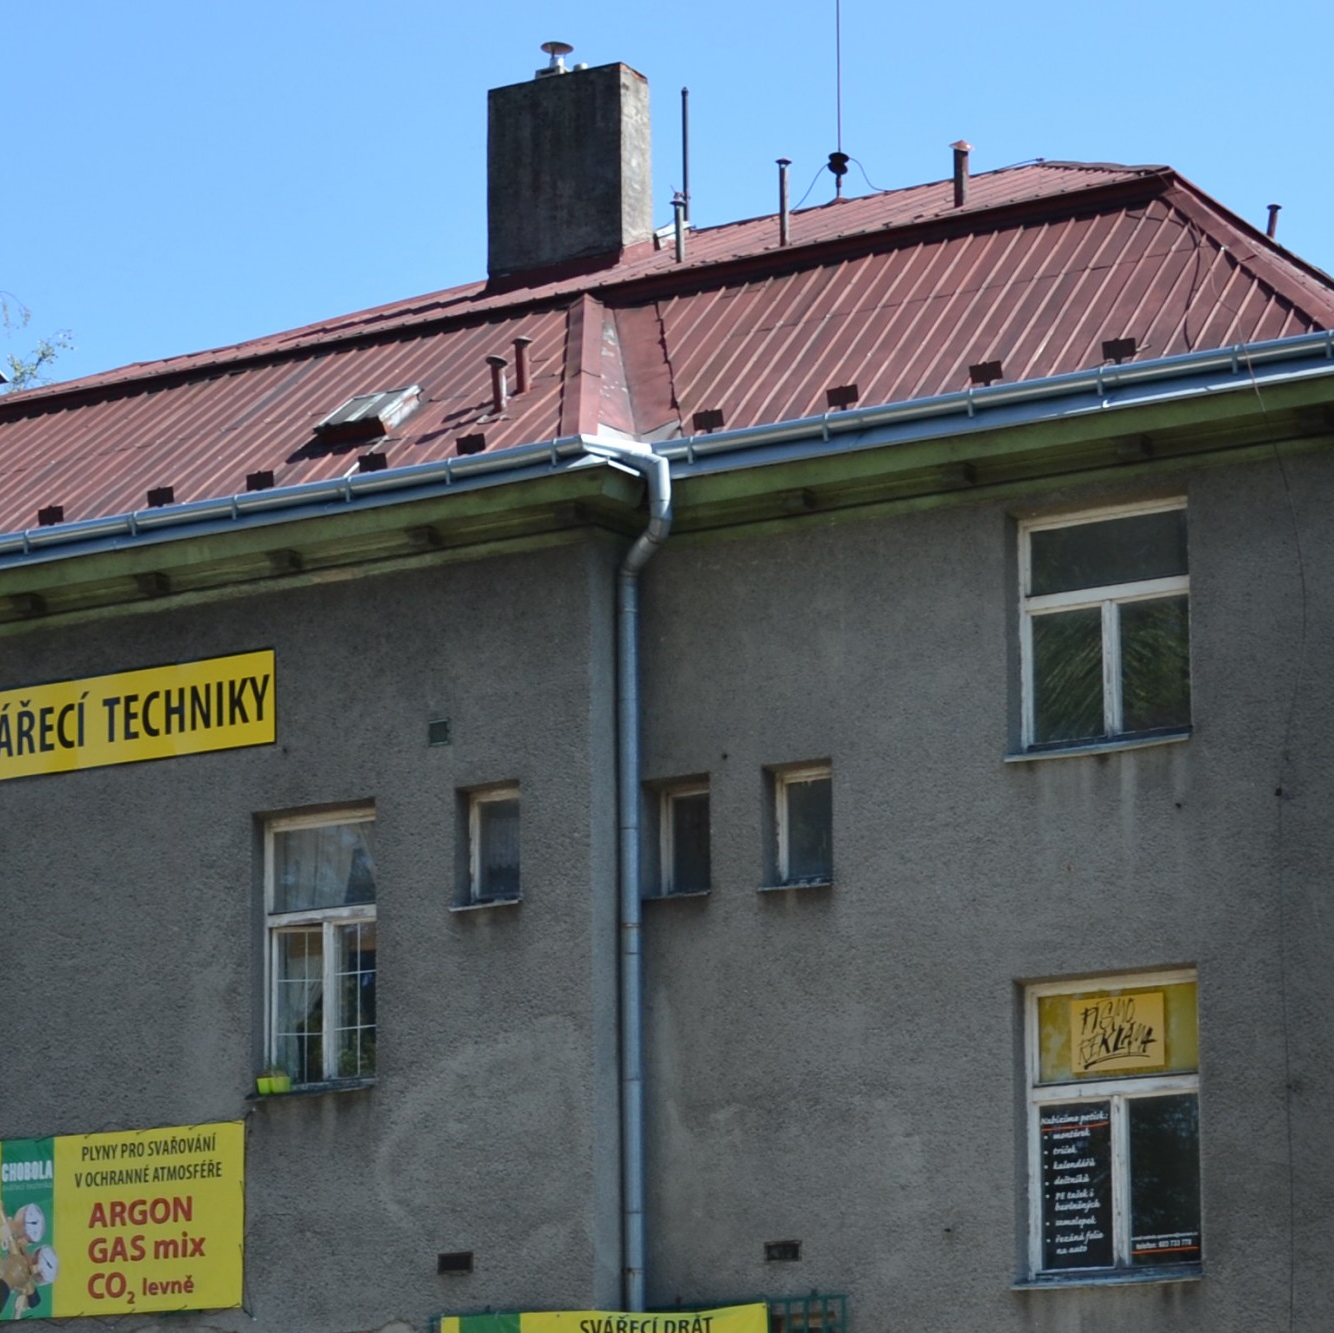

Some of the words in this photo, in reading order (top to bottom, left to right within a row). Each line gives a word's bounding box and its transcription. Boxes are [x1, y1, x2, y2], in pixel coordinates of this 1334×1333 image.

[103, 674, 270, 744] TECHNIKY
[82, 1143, 117, 1162] PLYNY
[121, 1142, 145, 1158] PRO
[148, 1132, 216, 1156] SVAŘOVÁNÍ
[1, 1160, 53, 1182] CHOBOLA
[75, 1173, 82, 1188] V
[85, 1165, 149, 1187] OCHRANNÉ
[152, 1161, 222, 1183] ATMOSFÉŘE
[88, 1196, 193, 1229] ARGON
[88, 1235, 146, 1264] GAS
[154, 1231, 206, 1259] mix
[142, 1275, 194, 1296] levně
